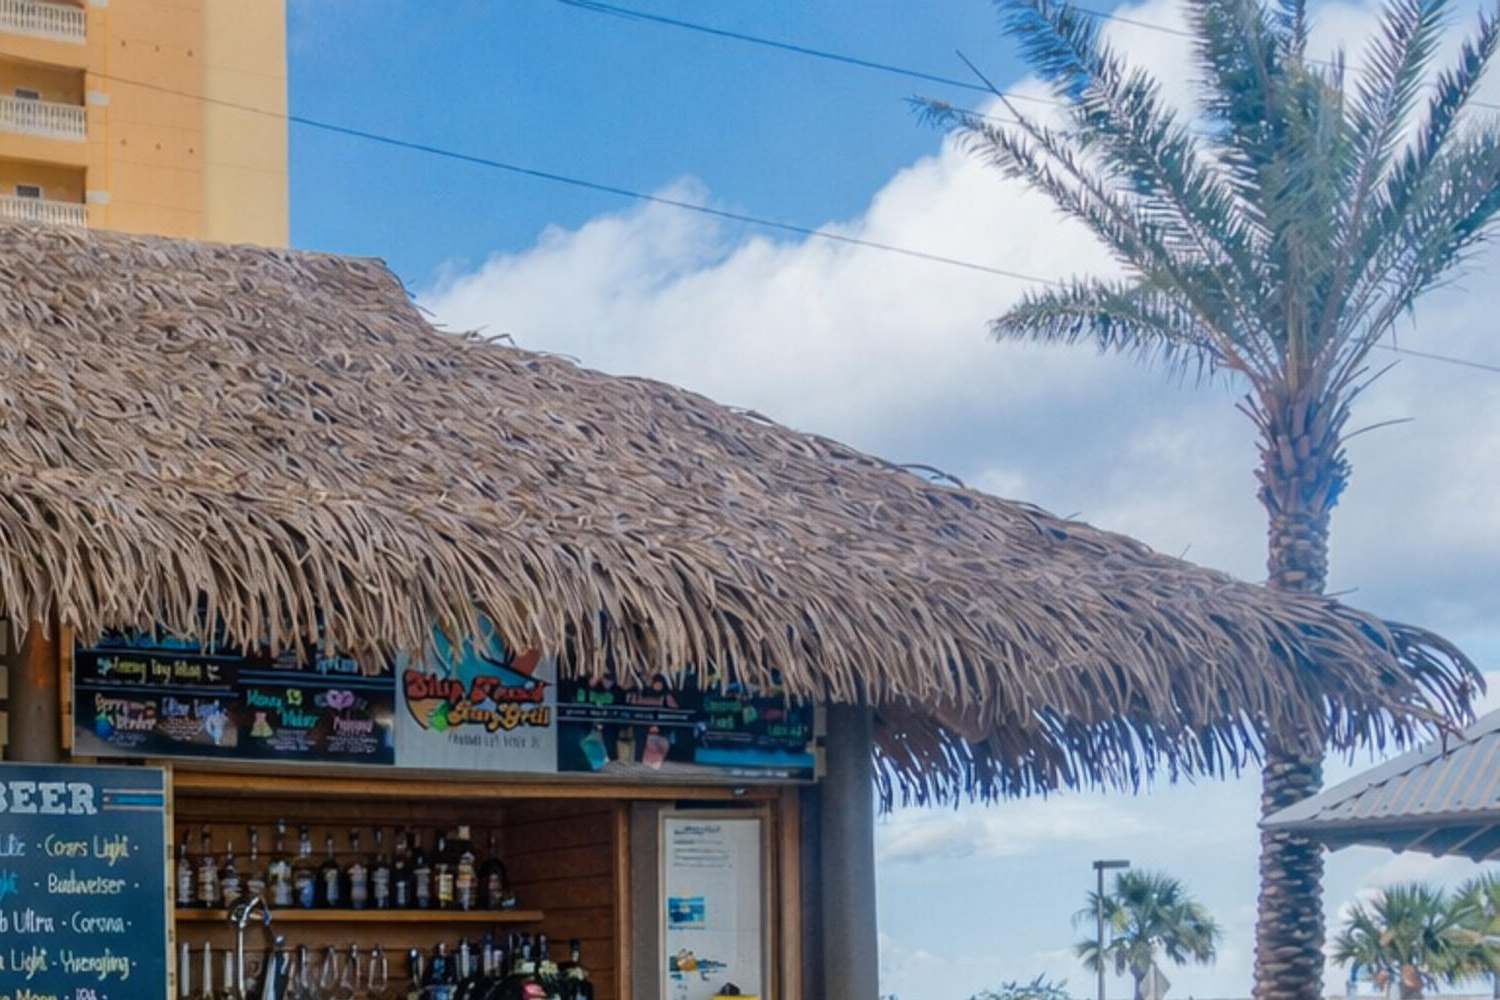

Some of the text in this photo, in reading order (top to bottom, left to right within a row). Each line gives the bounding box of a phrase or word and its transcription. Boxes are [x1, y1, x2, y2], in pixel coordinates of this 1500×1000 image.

[44, 833, 88, 857] Coors
[93, 834, 130, 867] Light
[47, 868, 127, 895] Budweiser
[13, 907, 55, 933] Ultra
[71, 910, 125, 934] Corona
[11, 946, 48, 980] Light
